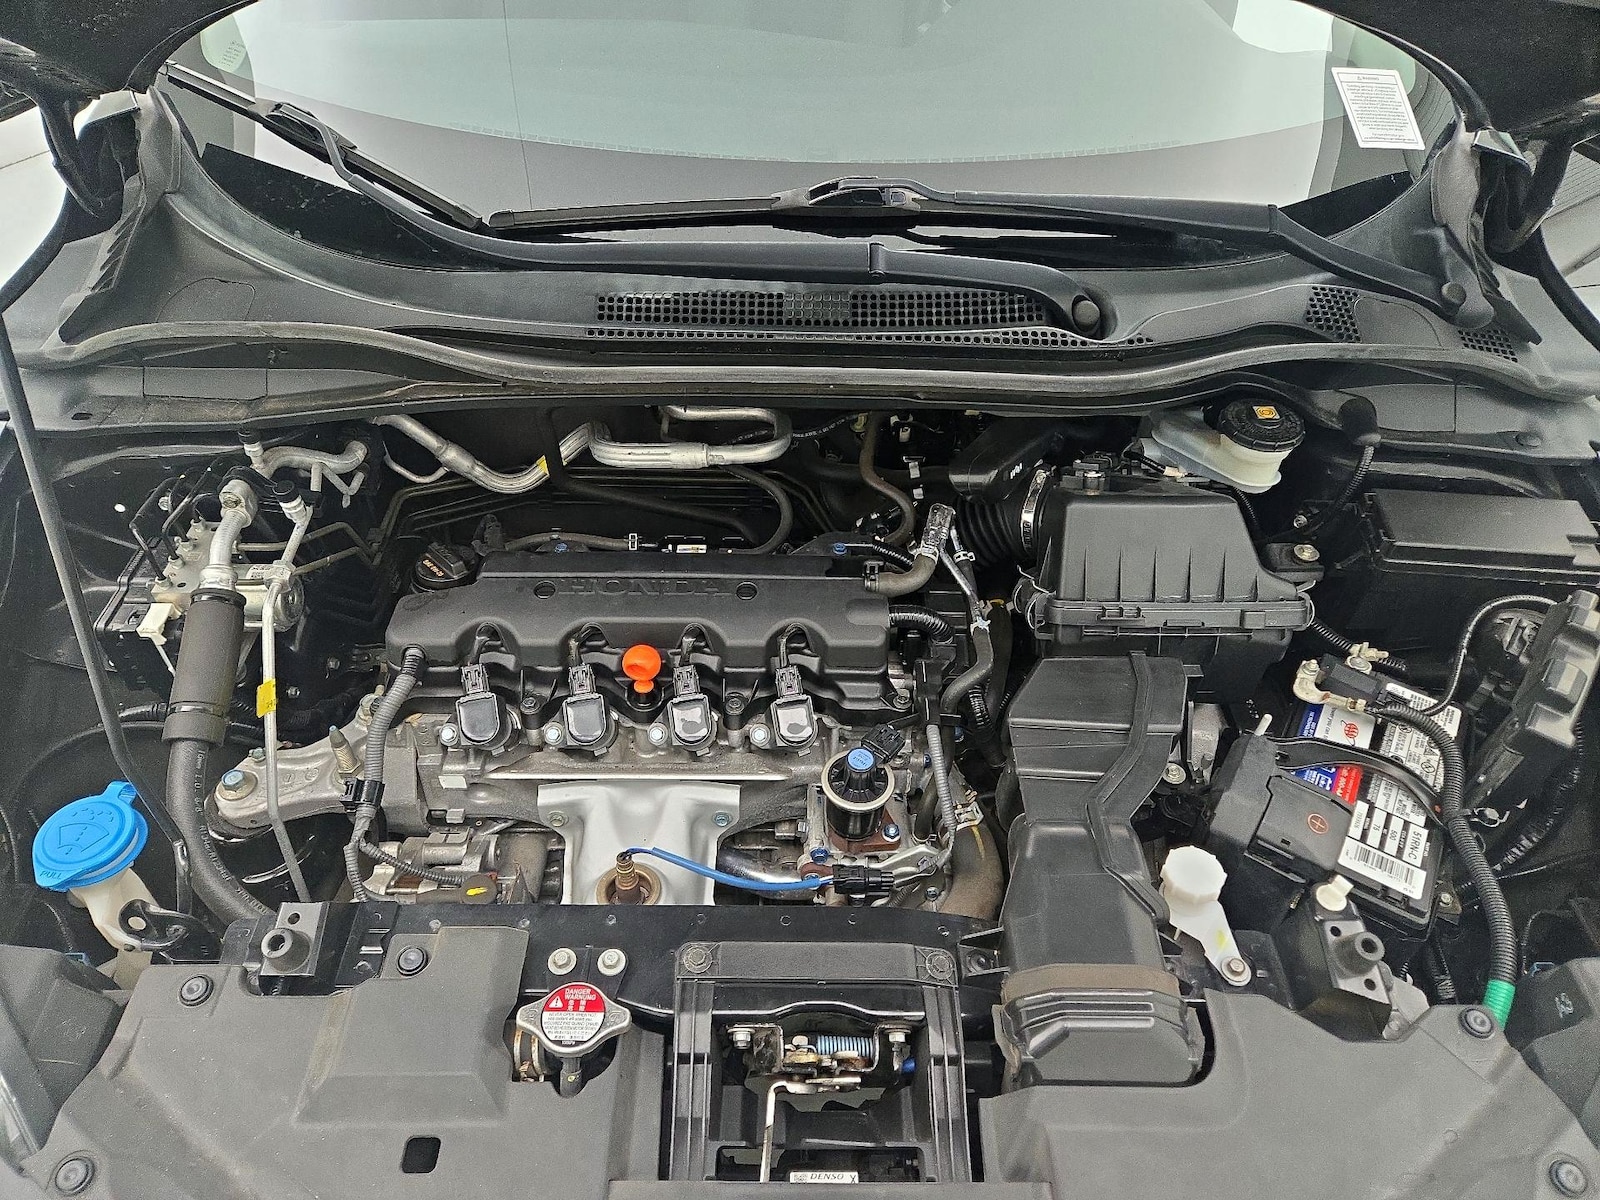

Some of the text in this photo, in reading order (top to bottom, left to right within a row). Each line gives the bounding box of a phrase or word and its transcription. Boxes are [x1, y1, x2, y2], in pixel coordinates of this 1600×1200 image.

[557, 577, 734, 597] HONDA
[1389, 830, 1398, 841] 500
[1408, 831, 1422, 860] 51RN-C
[40, 870, 62, 880] PULL
